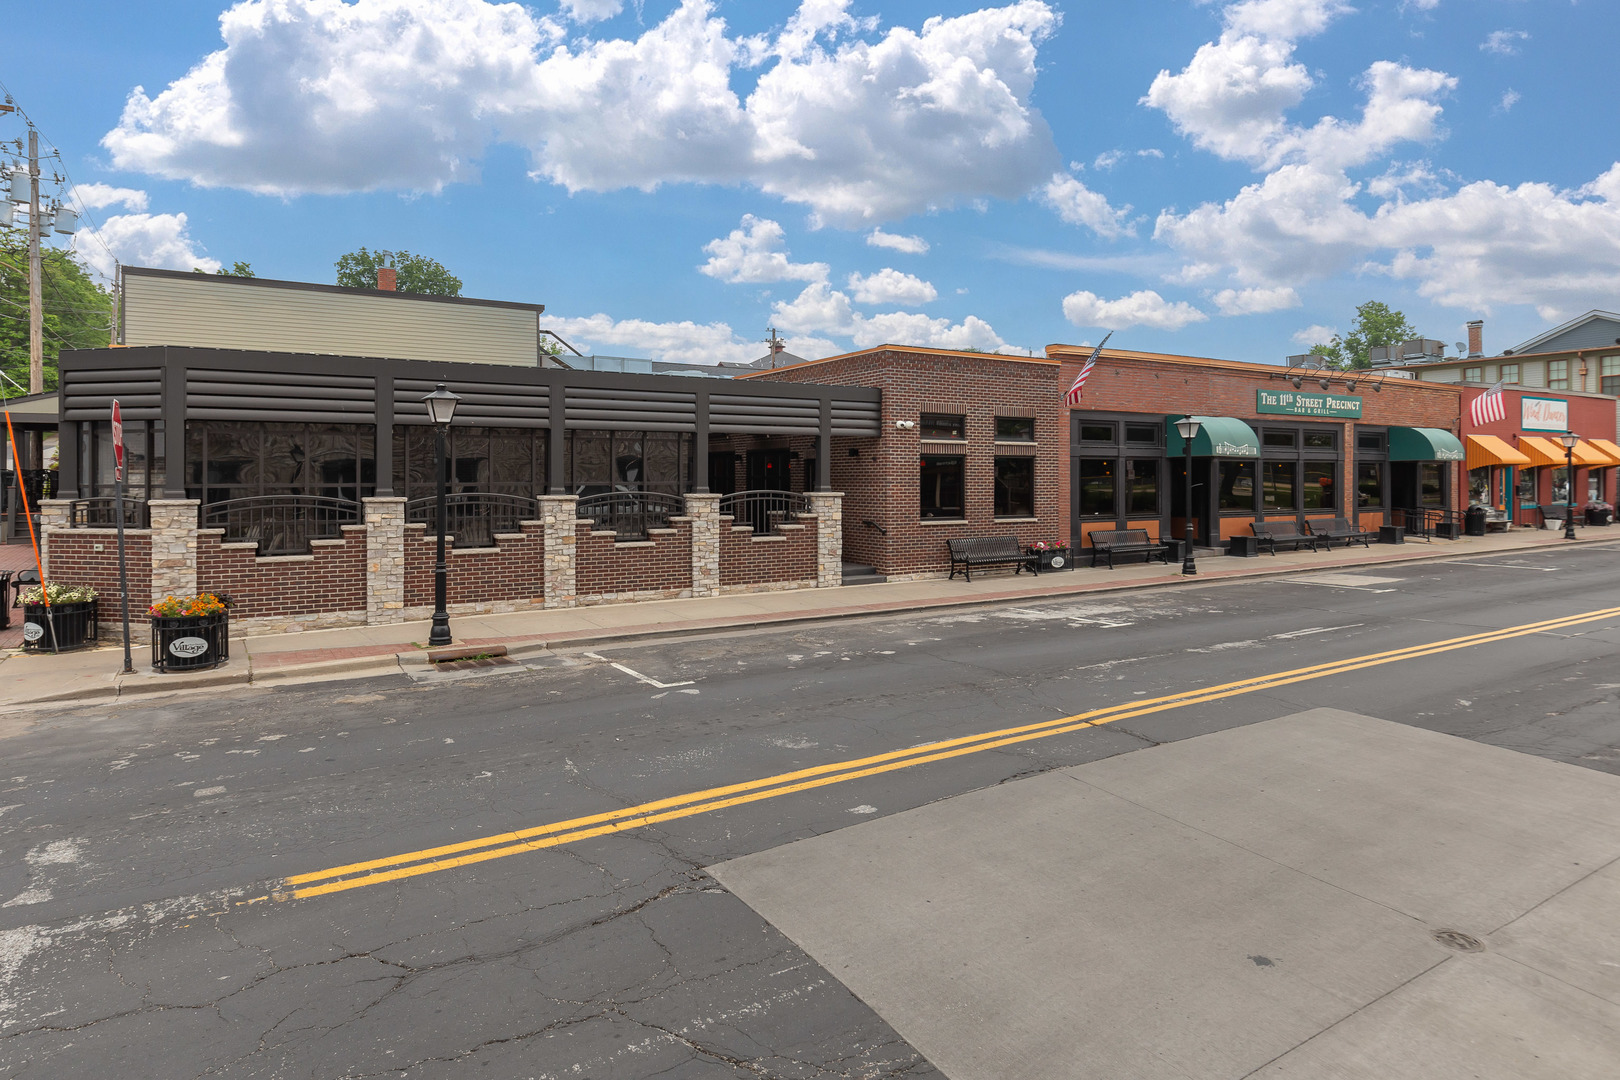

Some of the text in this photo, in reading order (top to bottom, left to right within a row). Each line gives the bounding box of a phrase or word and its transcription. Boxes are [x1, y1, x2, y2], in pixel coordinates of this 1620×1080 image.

[1261, 393, 1360, 410] THE 11th STREET PRECINCT
[114, 421, 122, 446] STOP
